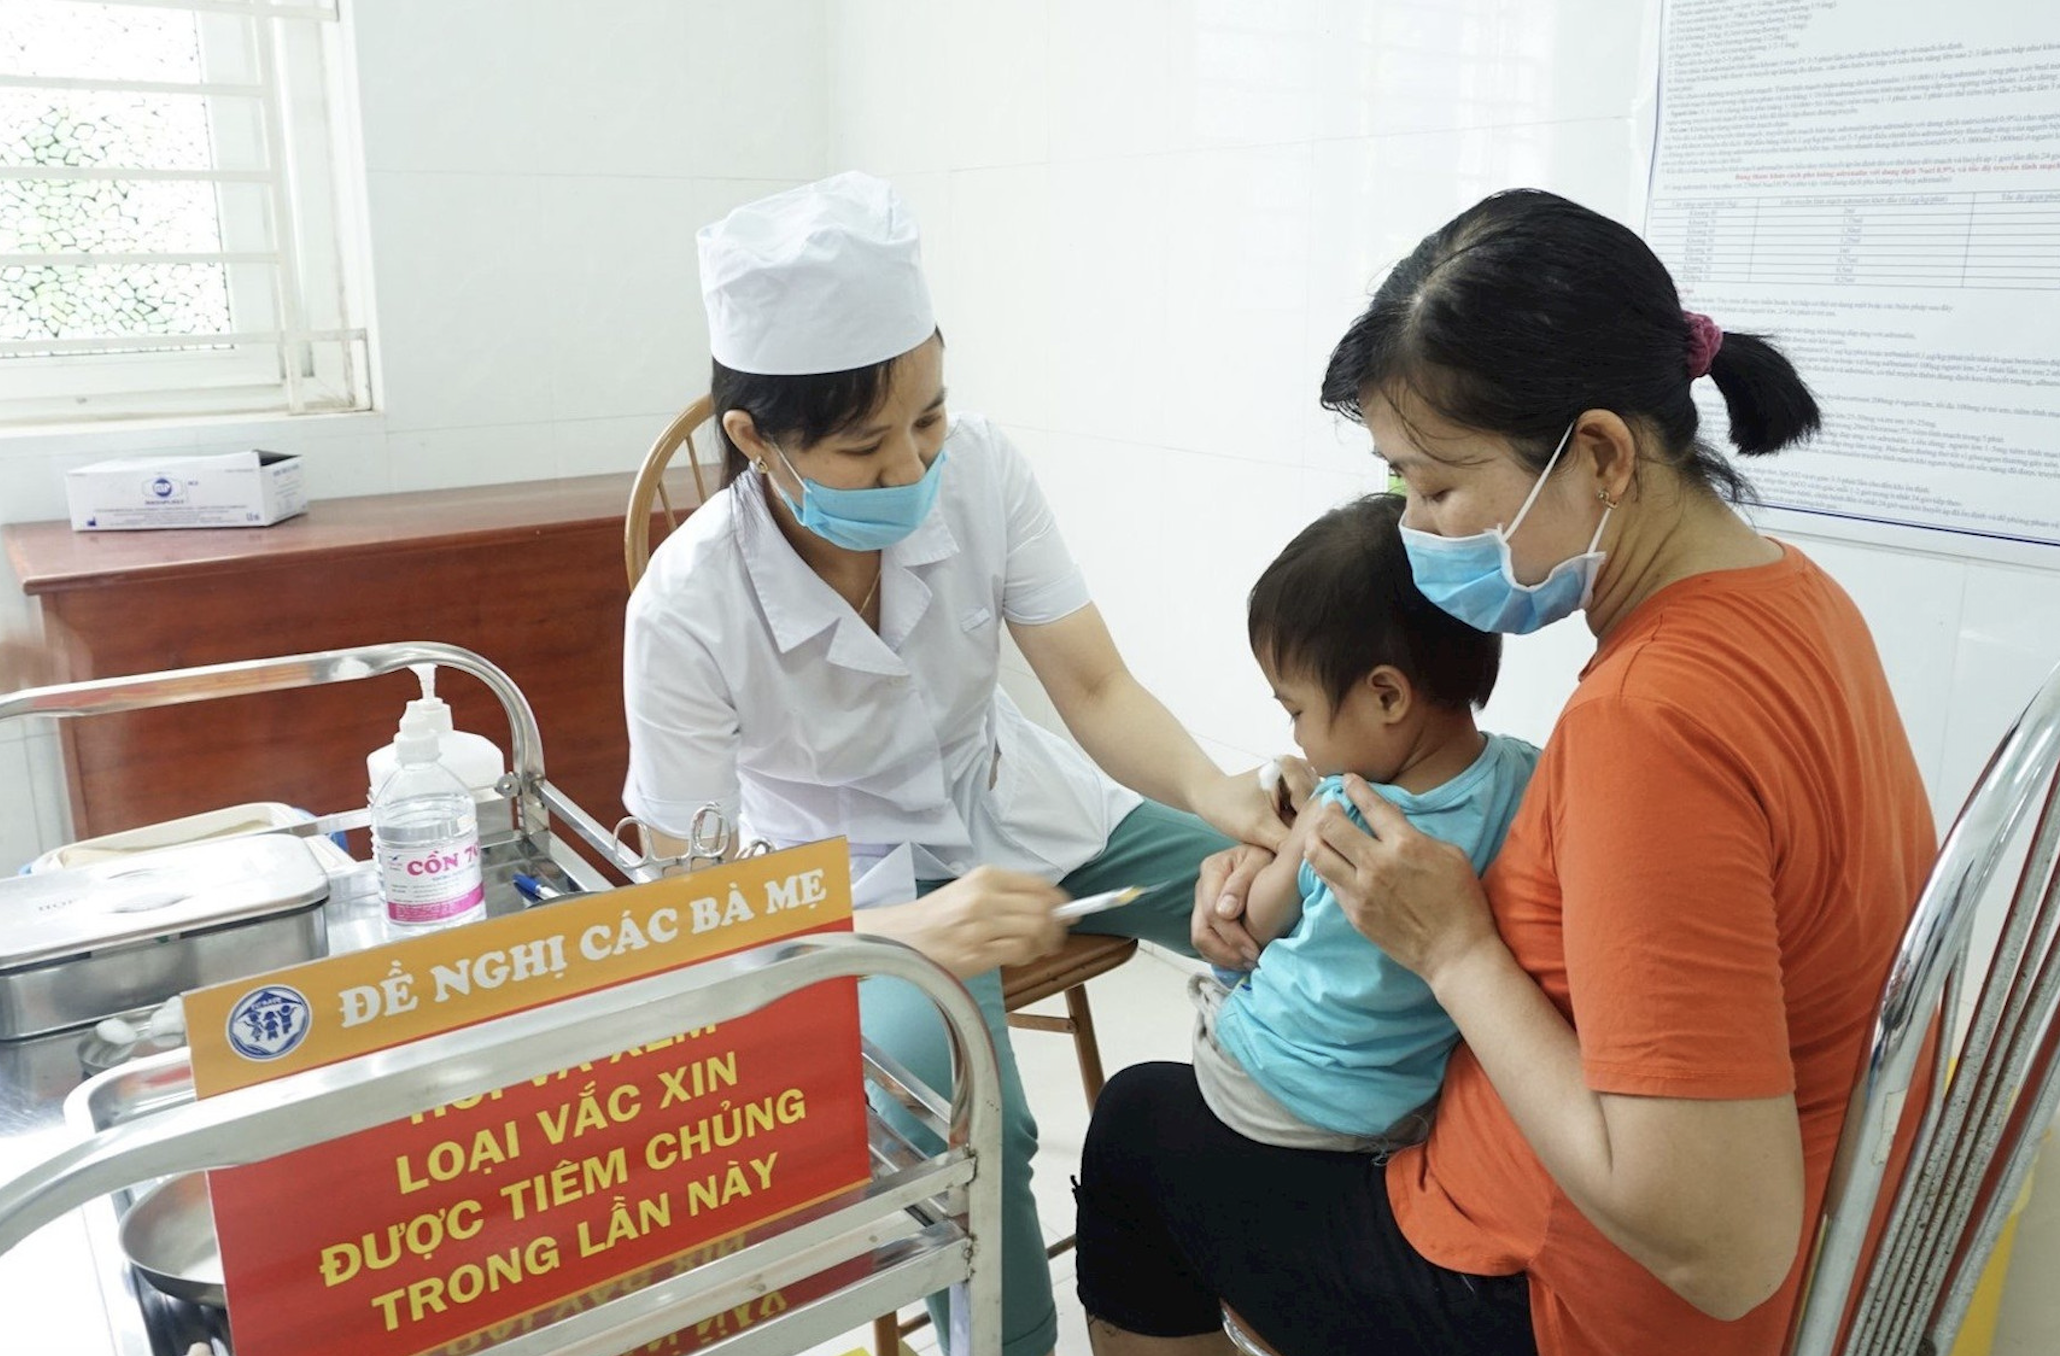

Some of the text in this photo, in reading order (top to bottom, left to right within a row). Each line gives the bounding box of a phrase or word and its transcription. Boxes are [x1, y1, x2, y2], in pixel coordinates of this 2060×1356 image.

[407, 850, 459, 876] CỒN
[340, 869, 827, 1028] ĐỀ NGHỊ CÁC BÀ MẸ
[319, 1089, 806, 1287] ĐƯỢC TIÊM CHỦNG
[397, 1121, 520, 1194] LOẠI
[537, 1081, 640, 1145] VẮC
[658, 1051, 737, 1109] XIN
[372, 1236, 560, 1331] TRONG
[578, 1193, 671, 1258] LẦN
[688, 1152, 778, 1216] NÀY
